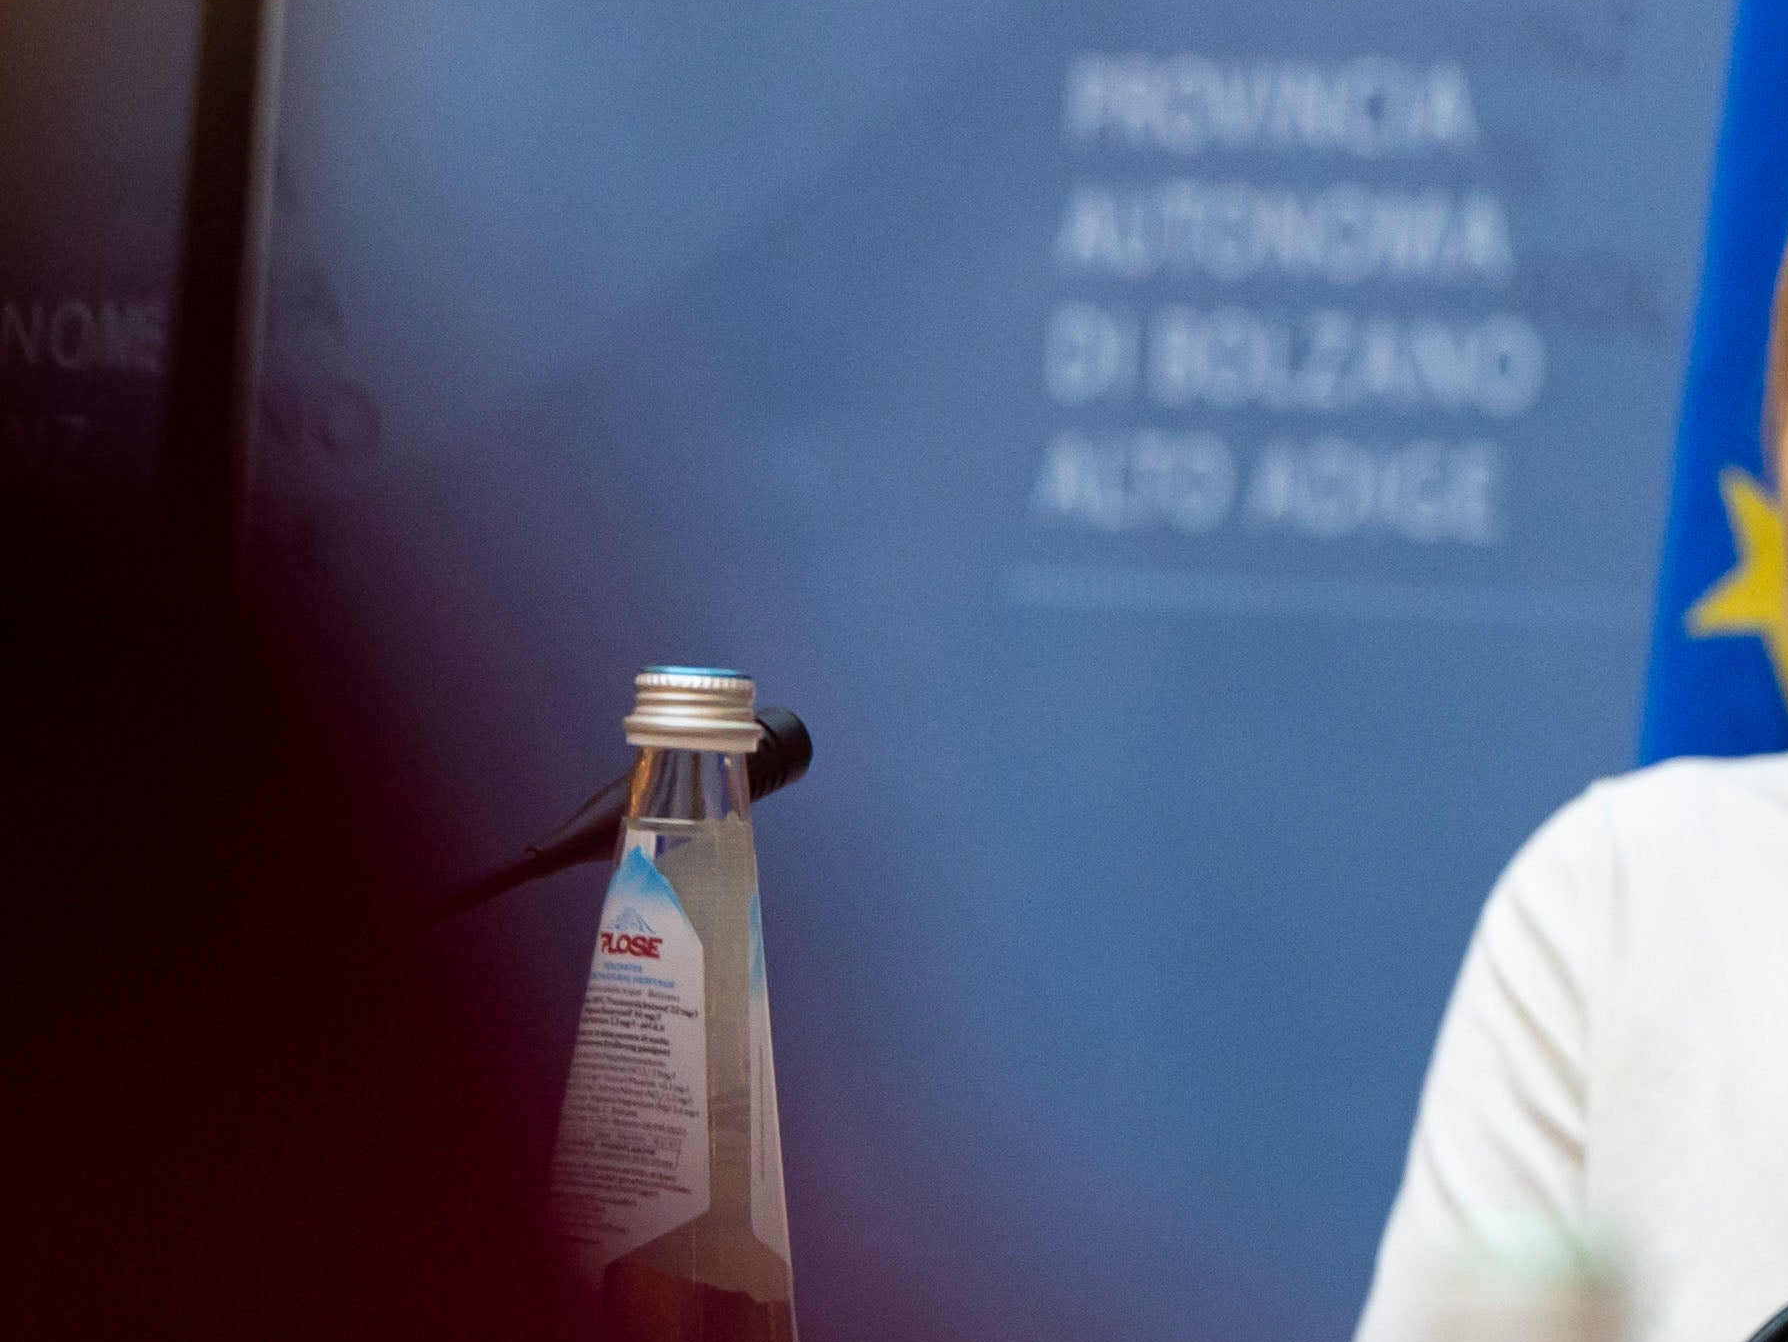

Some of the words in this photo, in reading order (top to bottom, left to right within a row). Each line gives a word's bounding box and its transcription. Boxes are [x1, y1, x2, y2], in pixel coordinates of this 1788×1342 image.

[1062, 53, 1477, 157] PROVINCIA
[1051, 182, 1516, 283] AUTONOMA
[1042, 301, 1137, 407] DI
[1149, 305, 1547, 419] BOLZANO
[1030, 430, 1236, 535] ALTO
[1243, 435, 1506, 547] ADIGE
